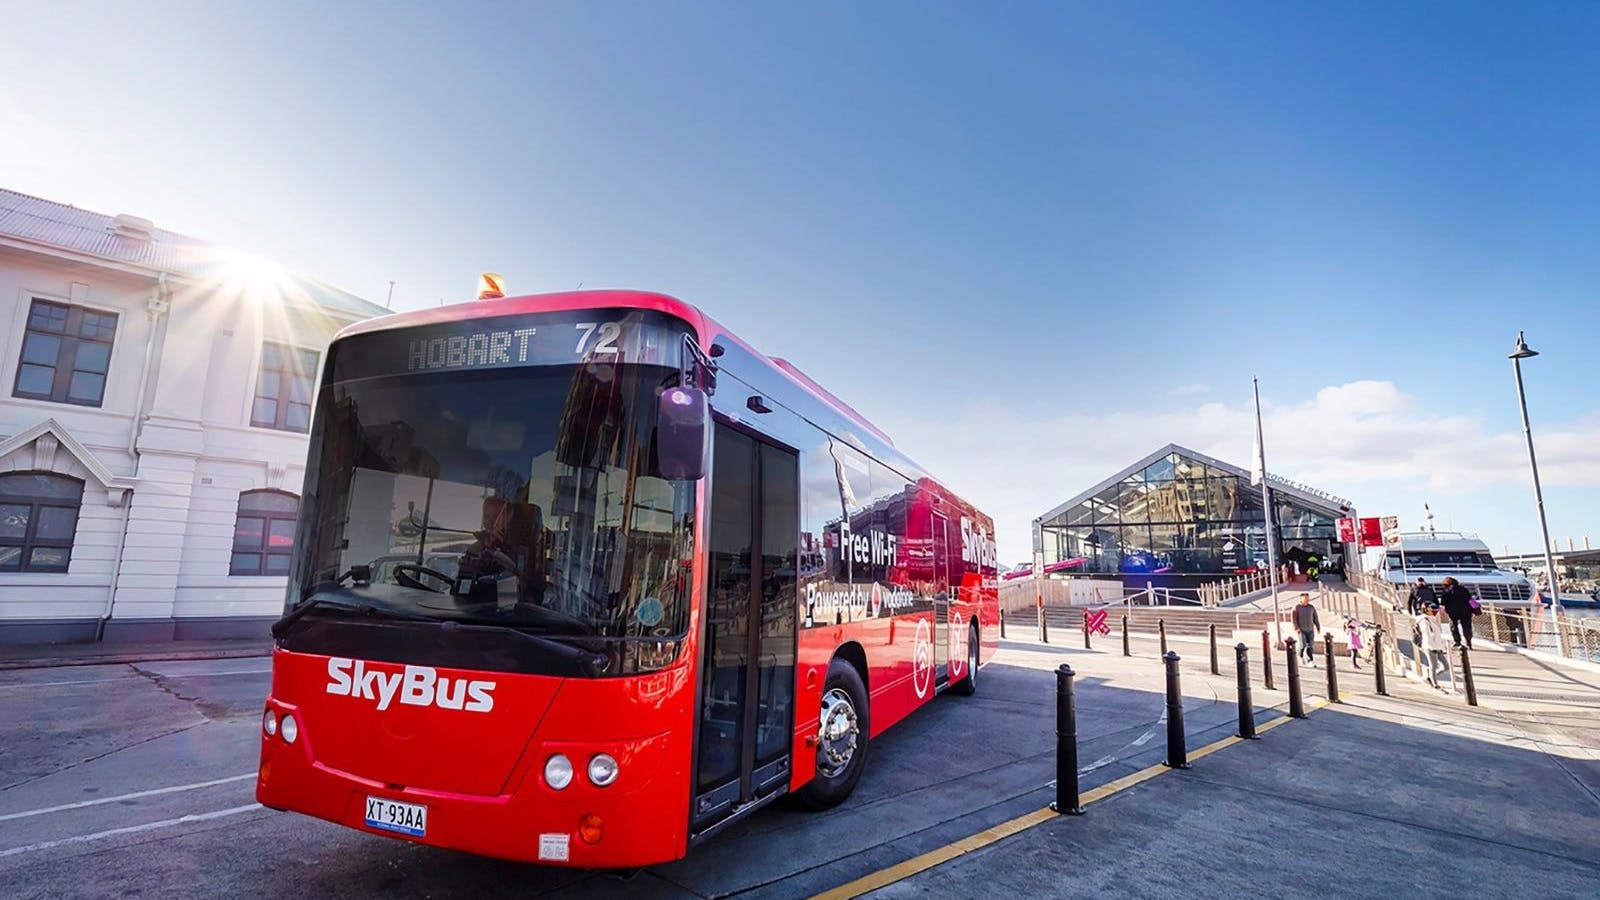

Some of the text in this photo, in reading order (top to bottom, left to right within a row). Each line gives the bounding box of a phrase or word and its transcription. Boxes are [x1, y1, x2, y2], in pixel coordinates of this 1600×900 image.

[408, 328, 536, 370] HOBART
[575, 322, 621, 354] 72
[1298, 483, 1330, 500] STREET
[1332, 495, 1352, 507] PIER
[841, 521, 896, 567] Free Wi-Fi
[961, 515, 997, 575] SkyBus
[807, 583, 914, 617] Powered by vodafone
[326, 657, 496, 712] SkyBus
